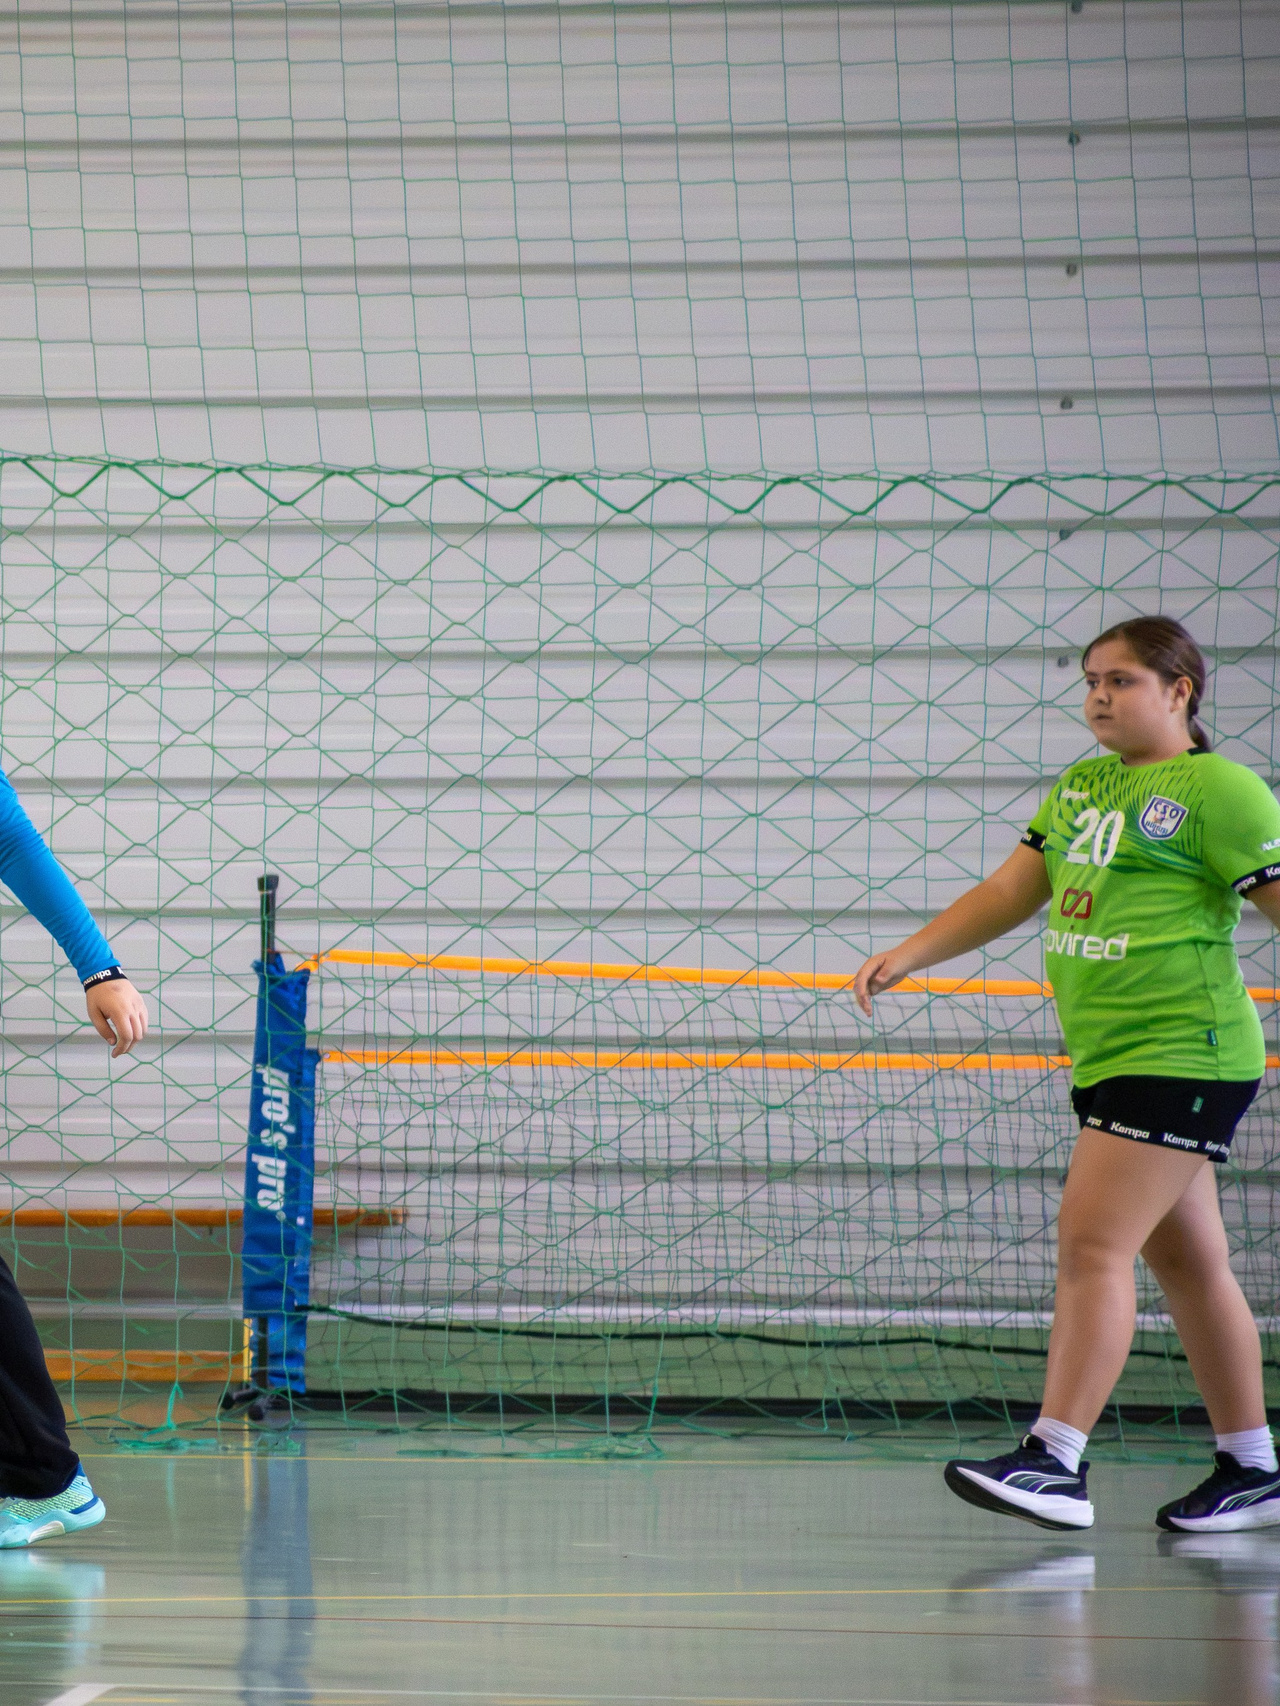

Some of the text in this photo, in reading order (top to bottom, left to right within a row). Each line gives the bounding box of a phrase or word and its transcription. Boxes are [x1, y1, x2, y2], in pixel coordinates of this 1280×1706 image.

[1154, 800, 1179, 819] CSO
[1067, 808, 1125, 867] 20
[251, 1063, 296, 1211] pro's pro
[1110, 1121, 1150, 1139] Kempa
[1163, 1132, 1199, 1149] Kempa
